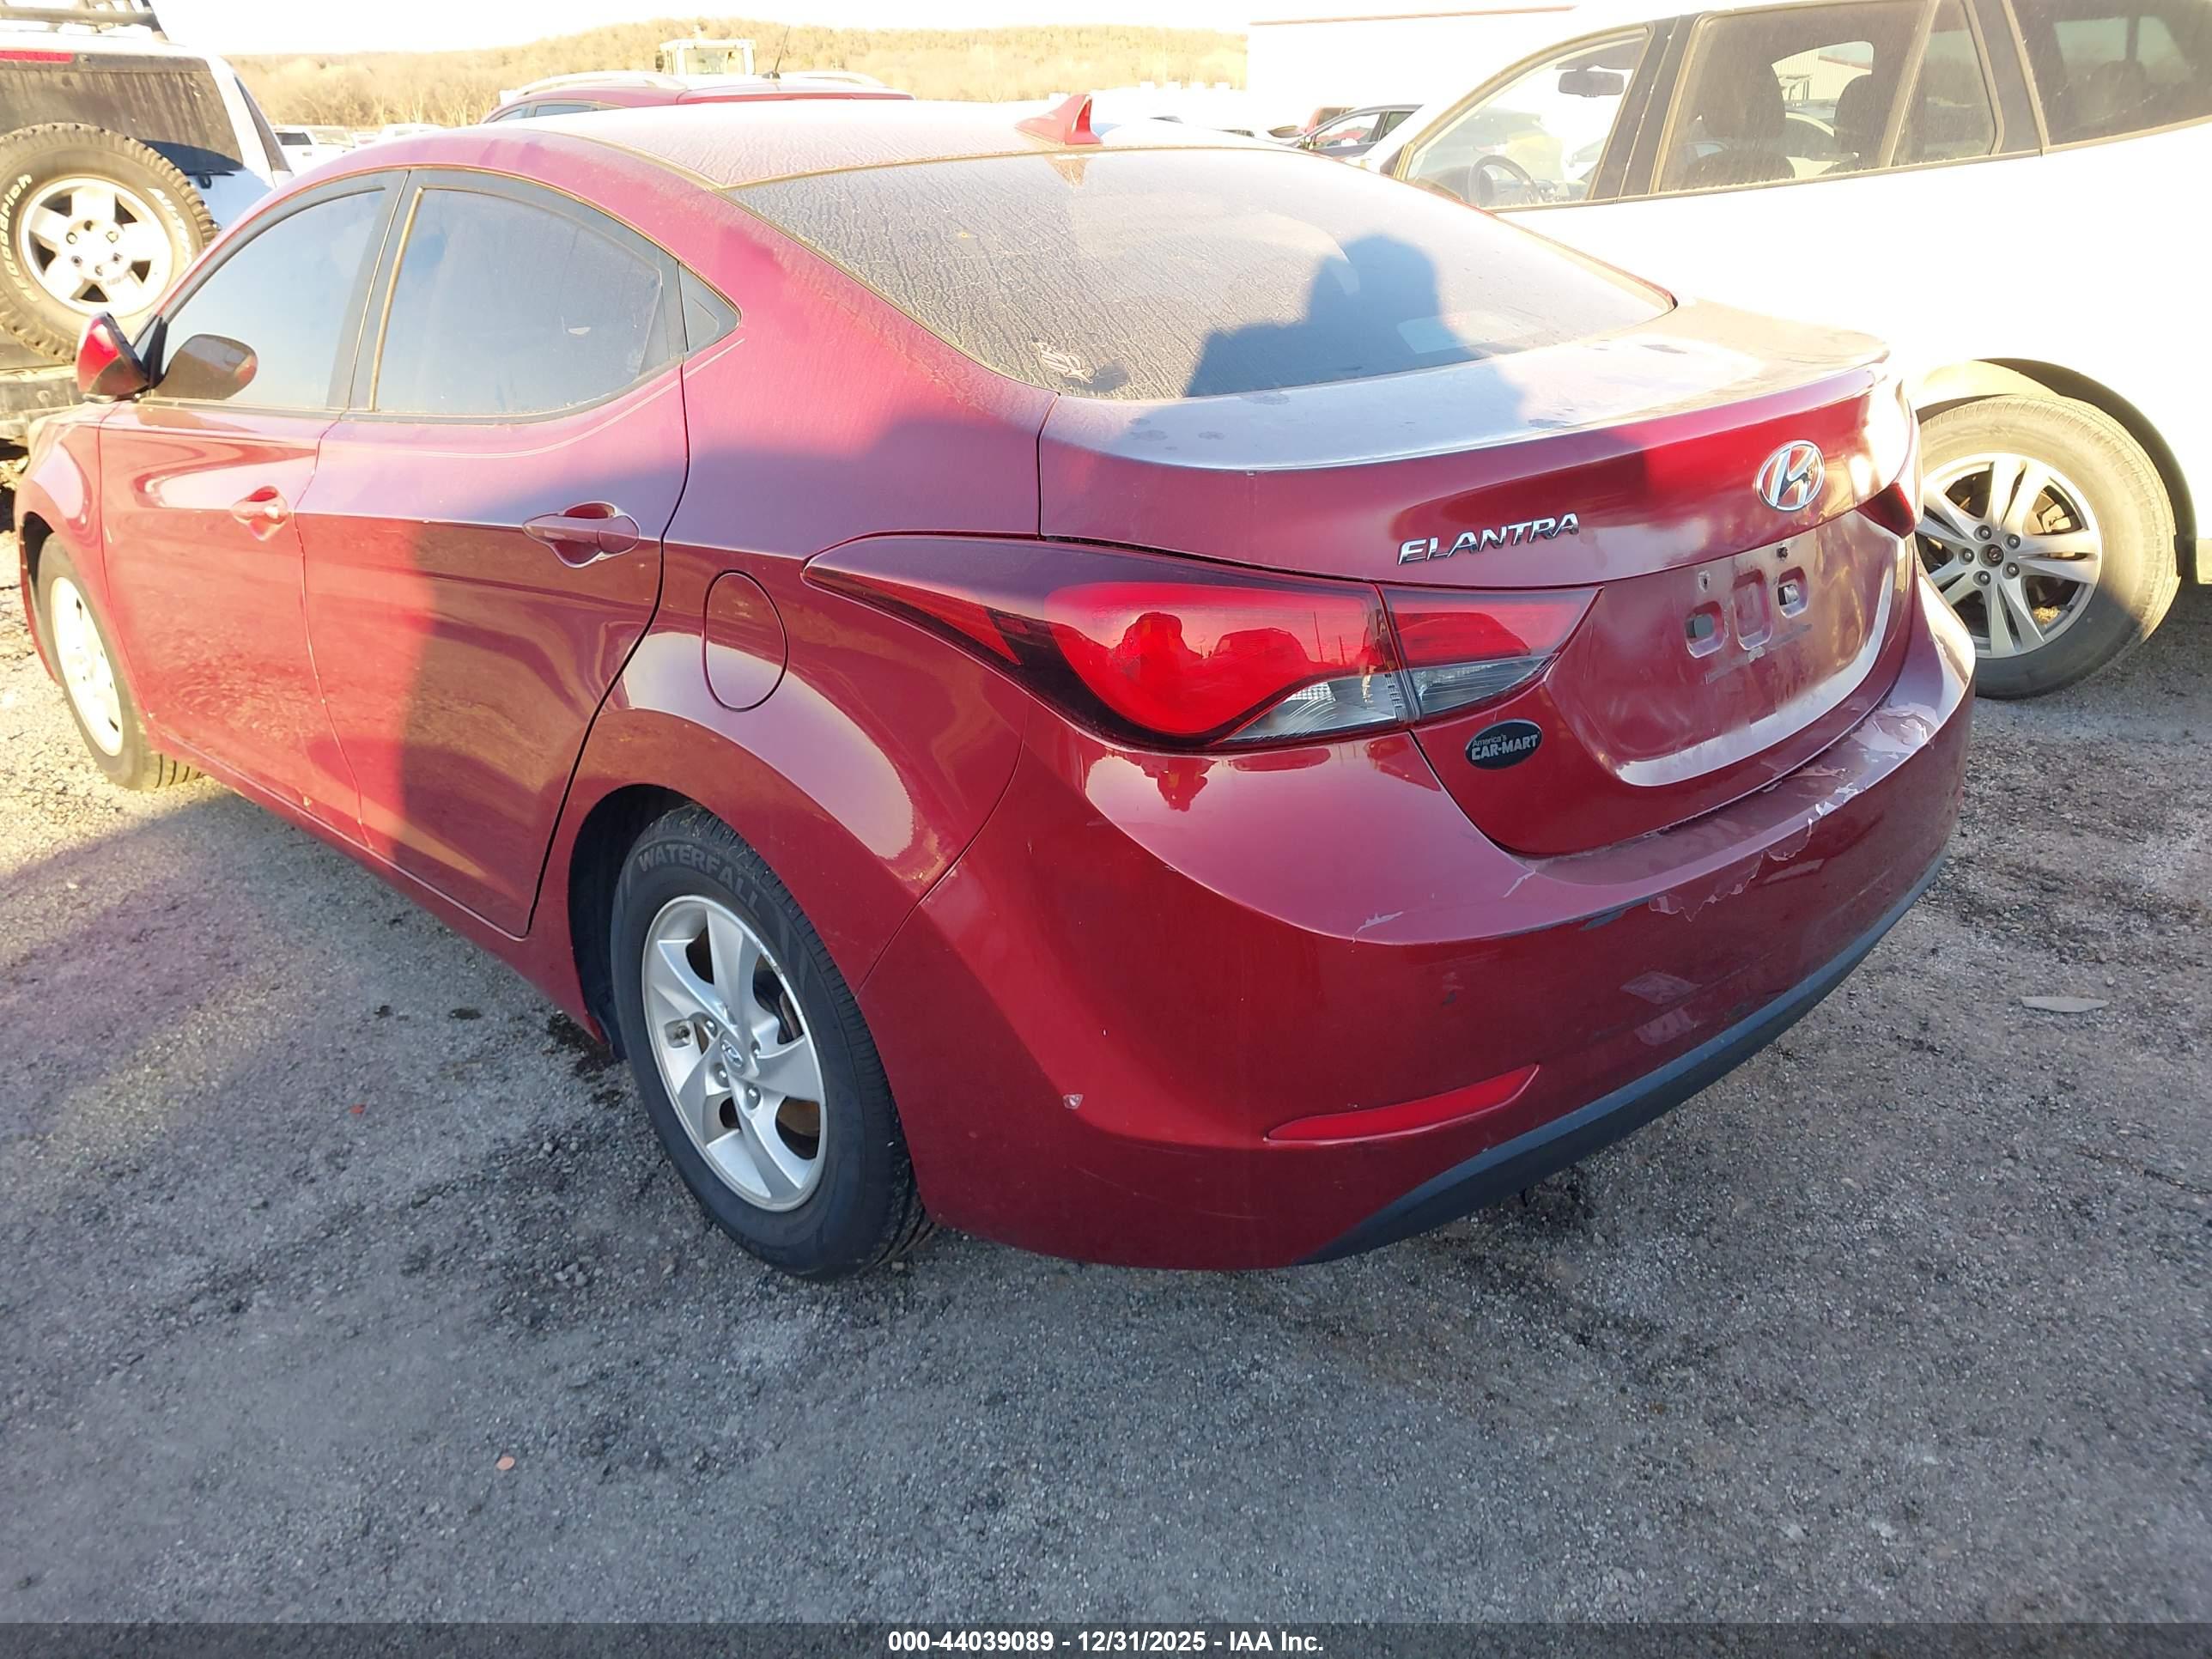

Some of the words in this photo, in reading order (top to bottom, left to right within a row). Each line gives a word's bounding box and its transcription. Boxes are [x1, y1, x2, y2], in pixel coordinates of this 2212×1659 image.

[1397, 513, 1579, 566] ELANTRA
[1471, 733, 1538, 761] CAR-MART
[1472, 733, 1507, 747] America's
[639, 843, 760, 918] WATERFALL
